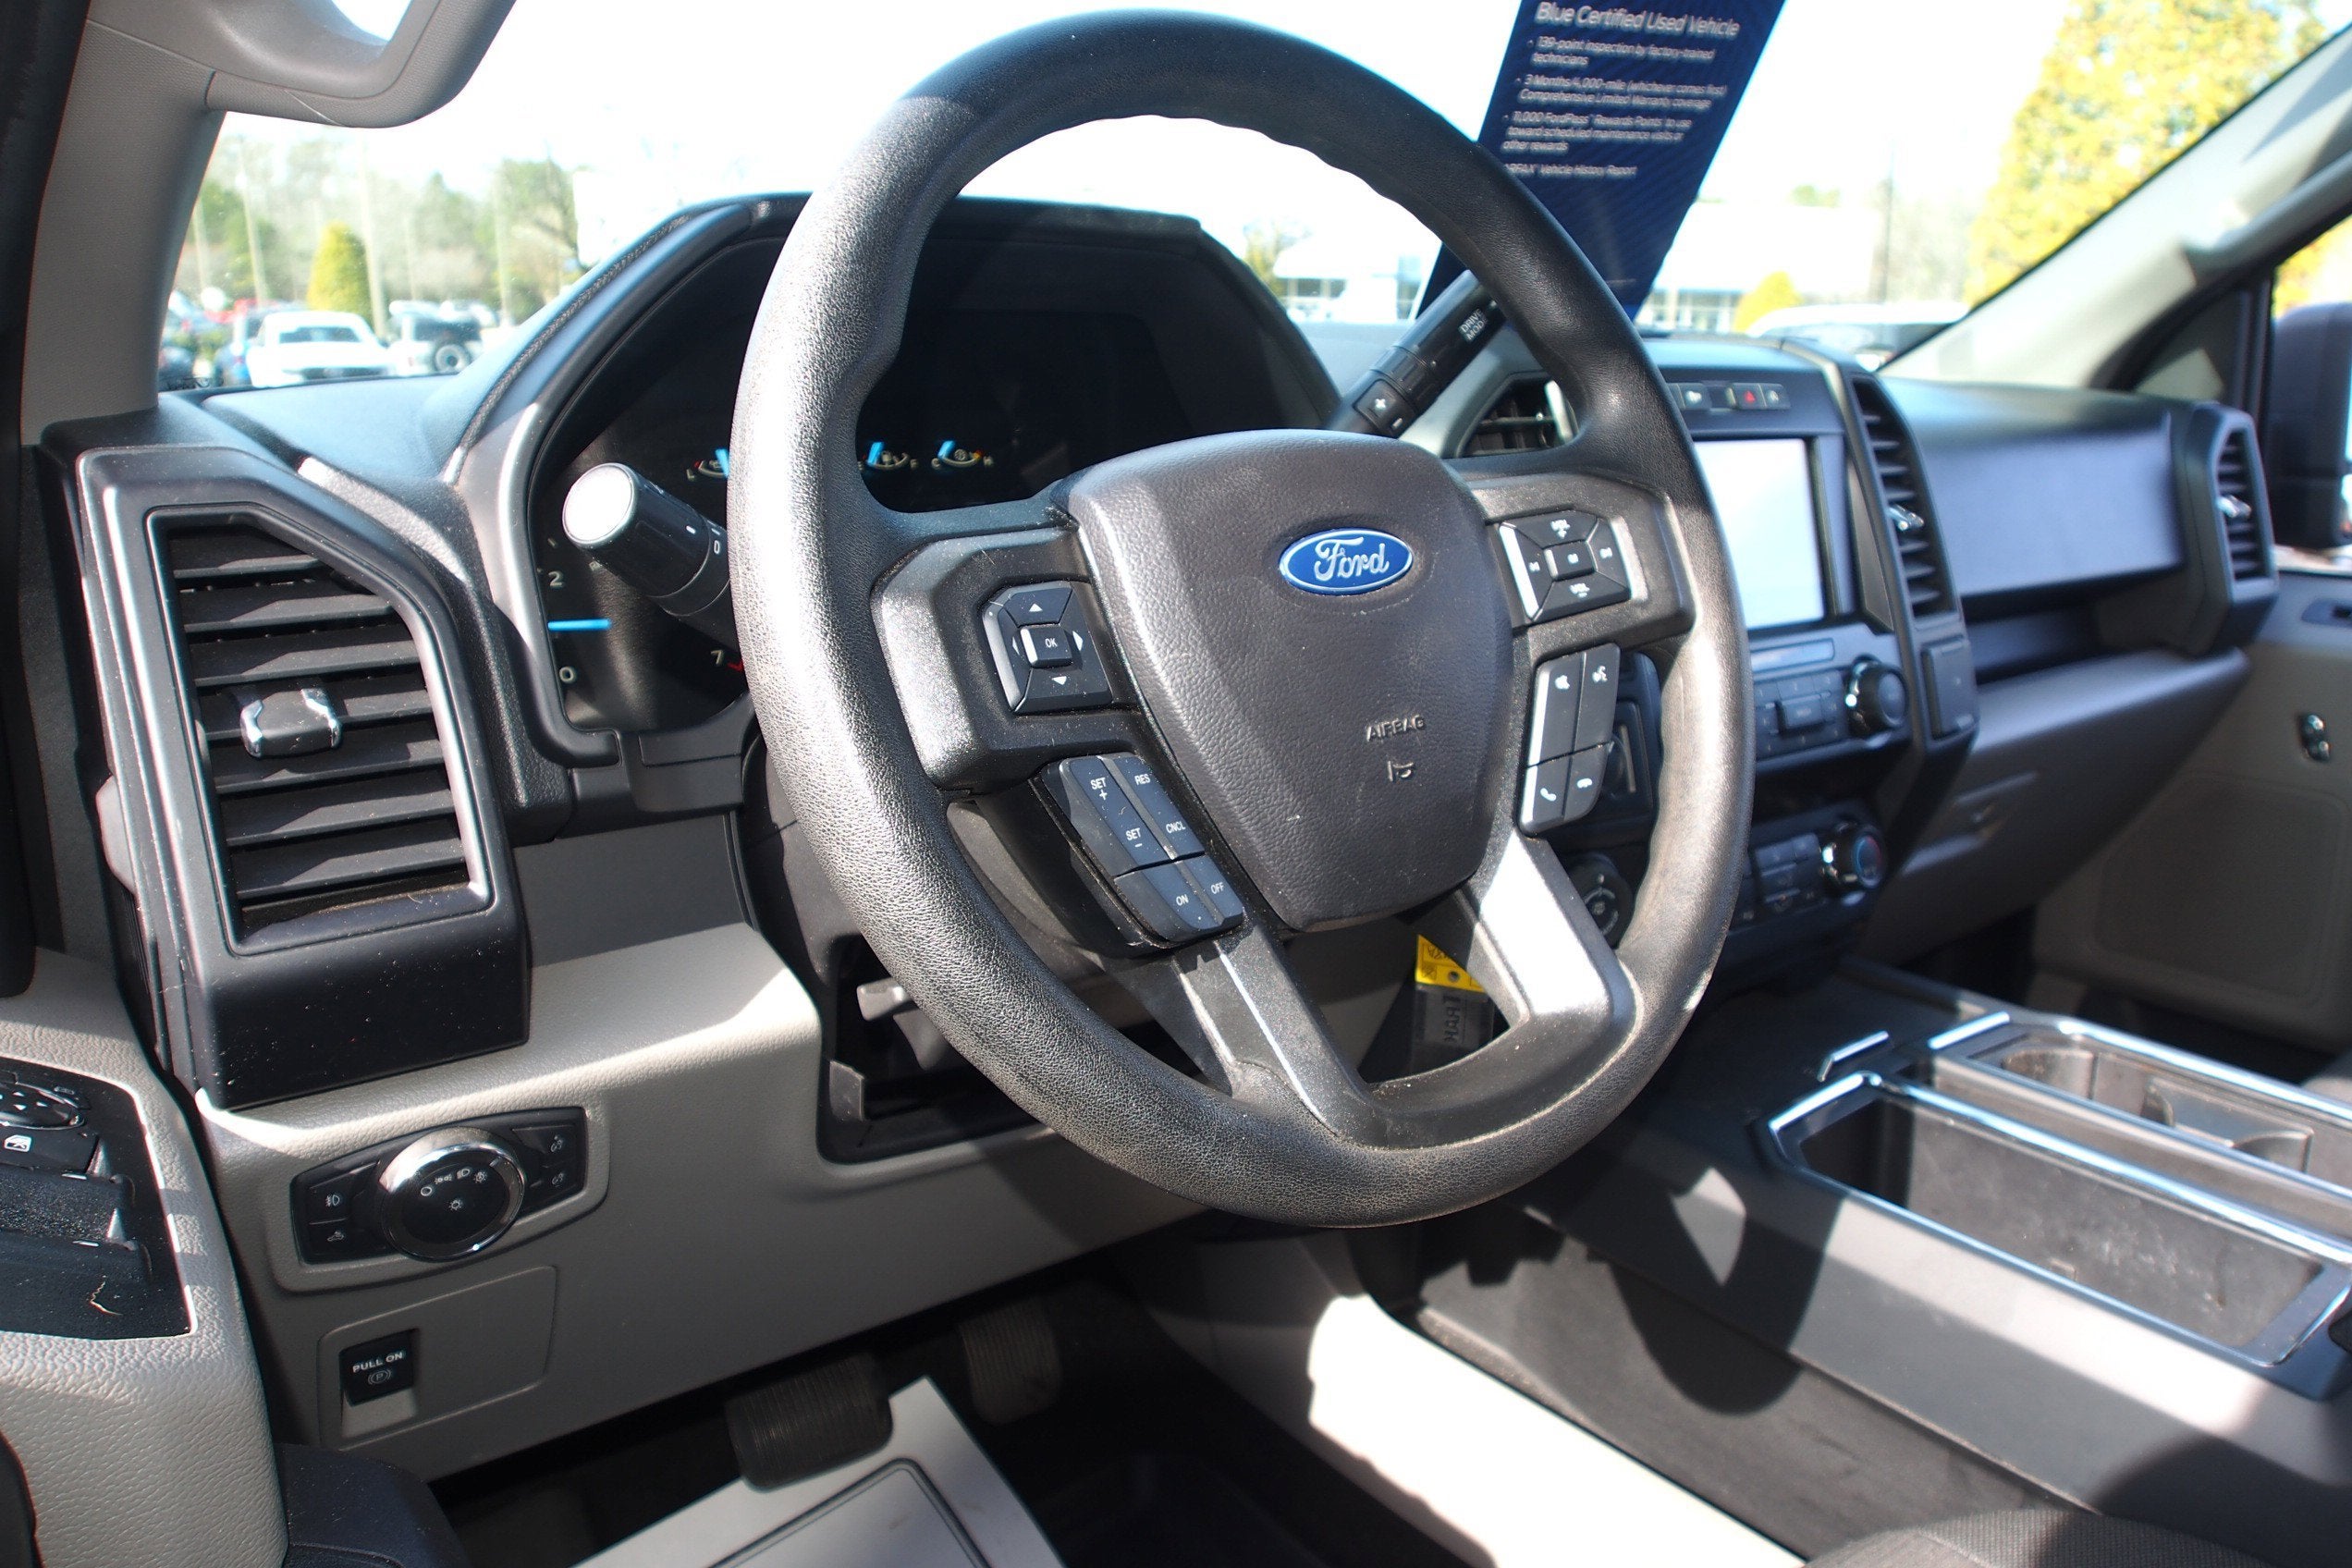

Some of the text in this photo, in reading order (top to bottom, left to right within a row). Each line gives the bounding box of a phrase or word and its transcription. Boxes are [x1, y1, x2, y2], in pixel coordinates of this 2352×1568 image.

[1536, 2, 1741, 38] Blue Certified Used Vehicle
[1585, 40, 1635, 55] inspection
[1532, 52, 1589, 66] technicians
[1675, 84, 1706, 96] comes
[1519, 89, 1711, 110] Comprehensive Limited Warranty coverage
[1593, 115, 1634, 128] Rewards
[1674, 119, 1692, 130] use
[1507, 126, 1543, 139] toward
[1542, 127, 1592, 140] scheduled
[1591, 129, 1650, 141] maintenance
[1501, 140, 1569, 153] other rewards
[1537, 165, 1574, 178] Vehicle
[1460, 308, 1482, 333] DRIVE
[1314, 536, 1390, 582] Ford
[548, 570, 564, 587] 2
[1045, 637, 1059, 649] OK
[711, 649, 723, 666] 7
[558, 666, 575, 683] 0
[1366, 714, 1426, 741] AIRBAG
[1090, 777, 1107, 790] SET
[1133, 773, 1151, 786] RES
[1125, 827, 1141, 841] SET
[1165, 821, 1187, 833] CNCL
[1210, 882, 1225, 894] OFF
[1175, 893, 1190, 906] ON
[352, 1352, 403, 1373] PULL ON
